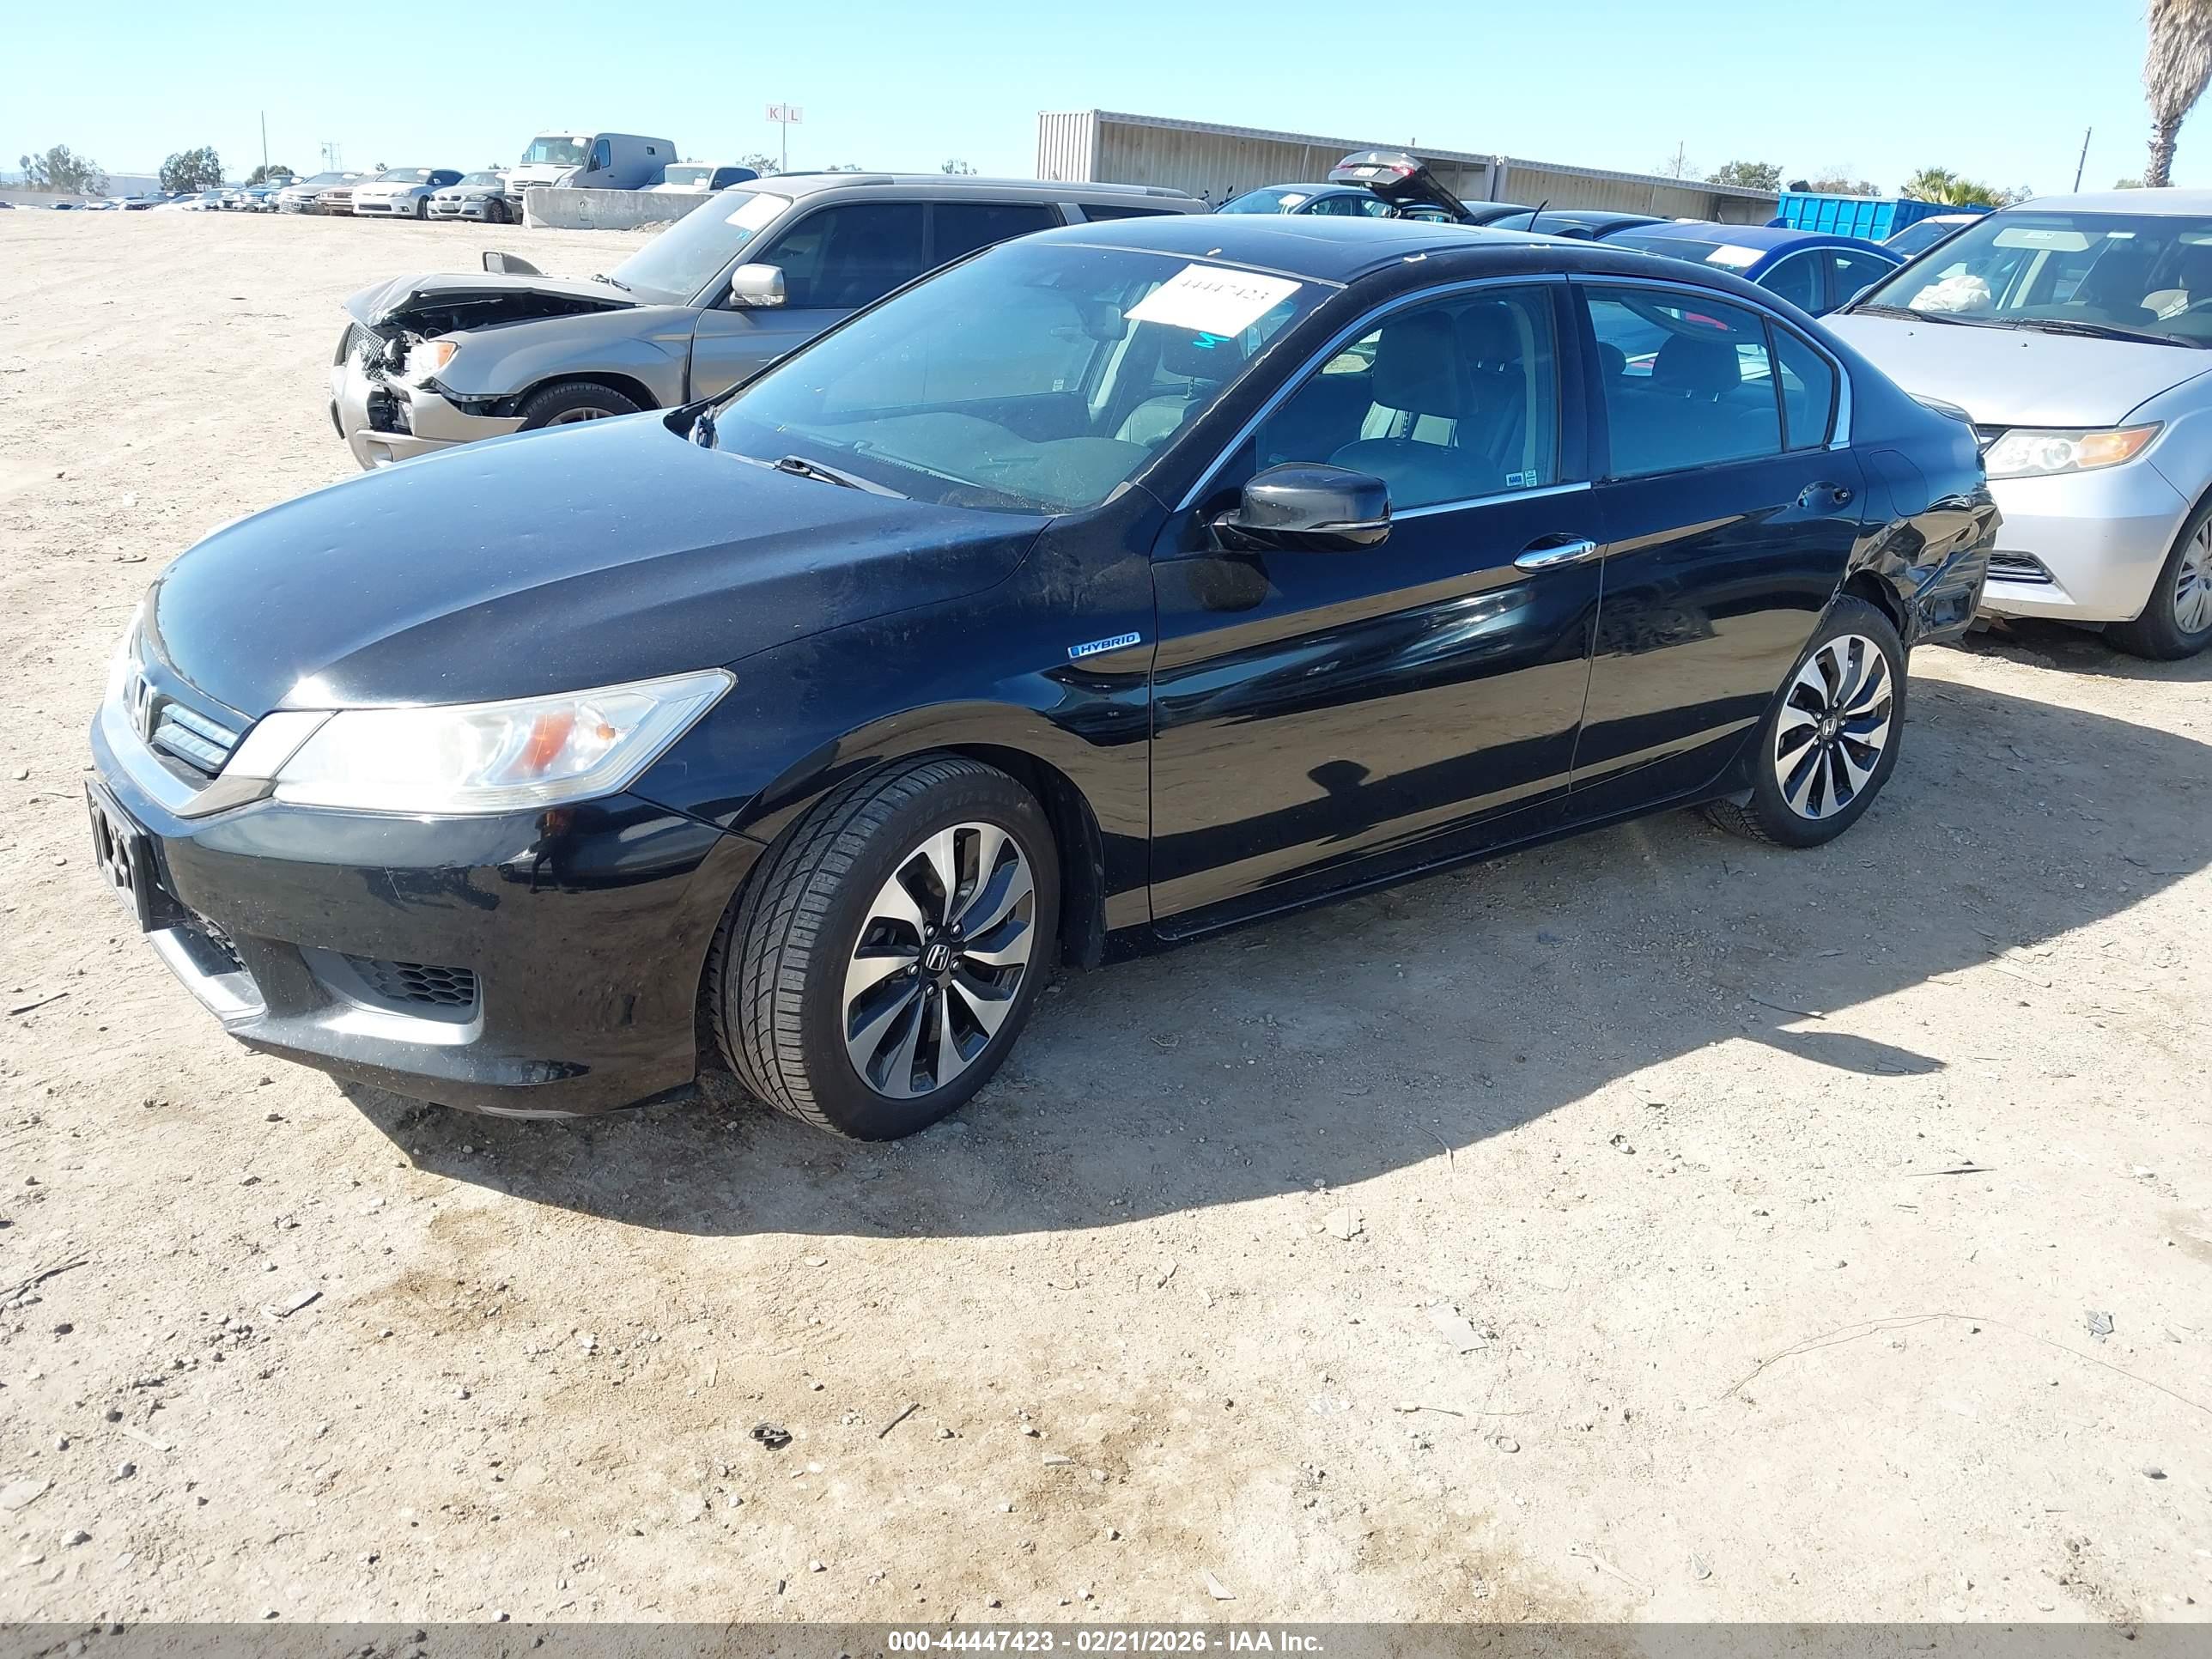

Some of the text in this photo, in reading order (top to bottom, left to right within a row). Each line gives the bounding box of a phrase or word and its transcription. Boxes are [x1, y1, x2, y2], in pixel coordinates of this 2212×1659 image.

[769, 107, 798, 121] K L
[1081, 635, 1135, 654] HYBRID
